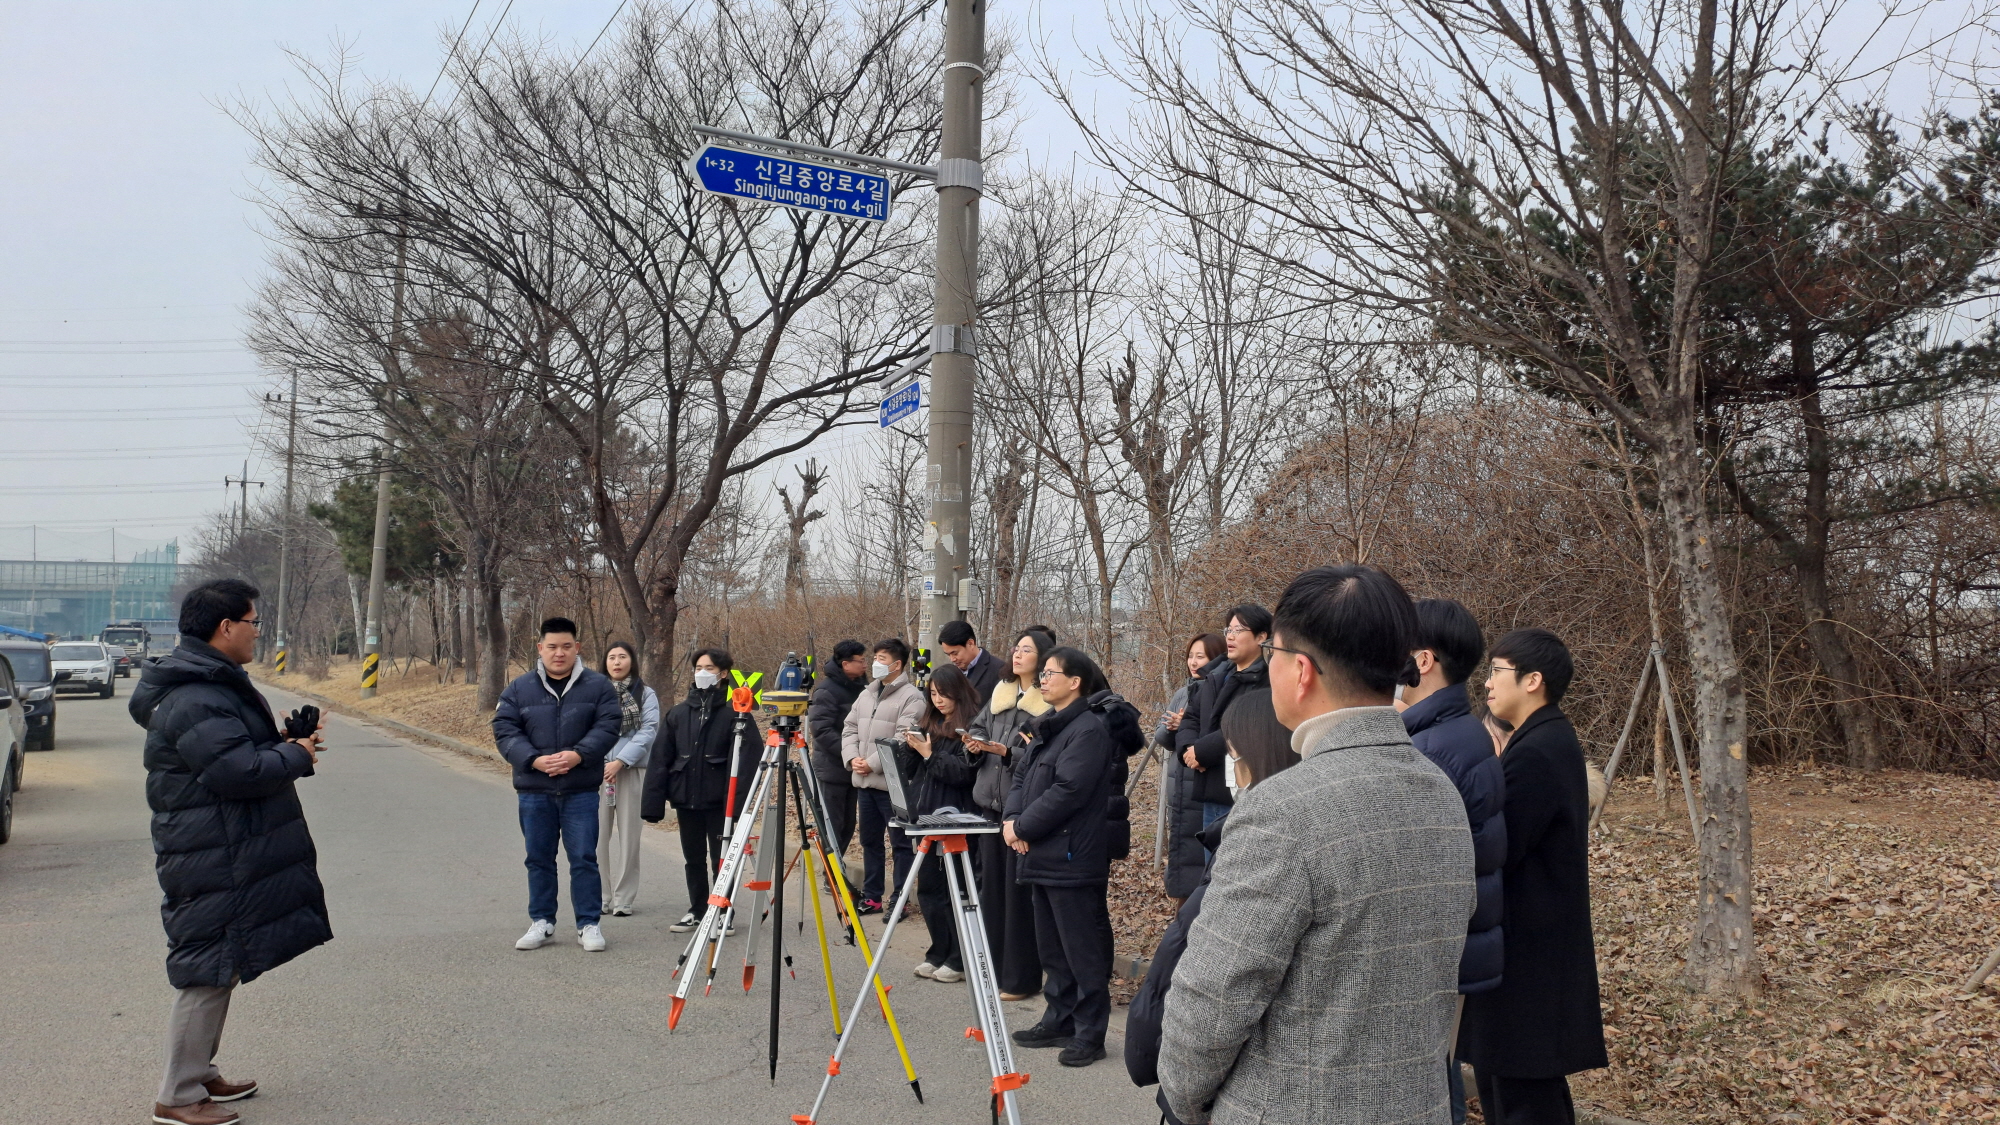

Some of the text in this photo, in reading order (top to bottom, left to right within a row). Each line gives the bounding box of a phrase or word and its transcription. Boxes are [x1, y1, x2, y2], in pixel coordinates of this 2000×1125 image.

[718, 159, 735, 172] 32
[755, 159, 884, 202] 신길중앙로4길
[734, 178, 883, 218] Singiljungang-ro 4-gil
